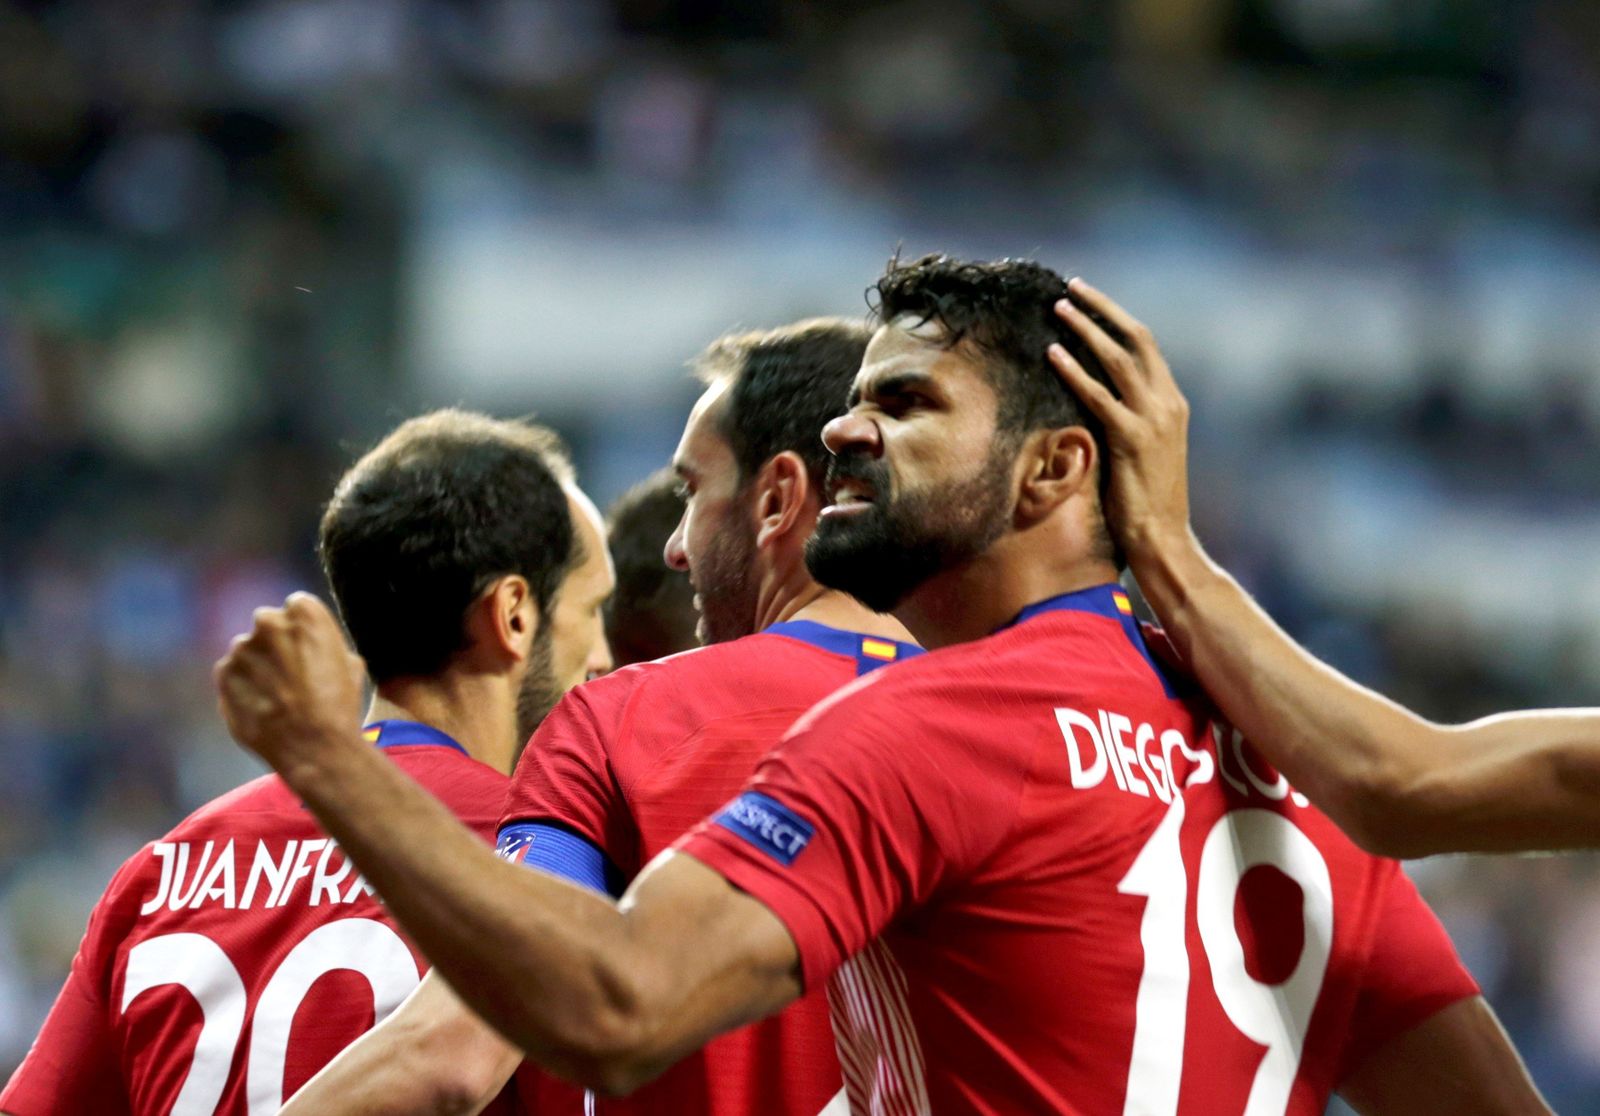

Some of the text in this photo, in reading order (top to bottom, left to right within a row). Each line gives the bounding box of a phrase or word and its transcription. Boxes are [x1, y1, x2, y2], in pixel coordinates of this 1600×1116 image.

[1053, 707, 1214, 805] DIEGO
[121, 917, 421, 1116] 20
[1114, 795, 1333, 1116] 19
